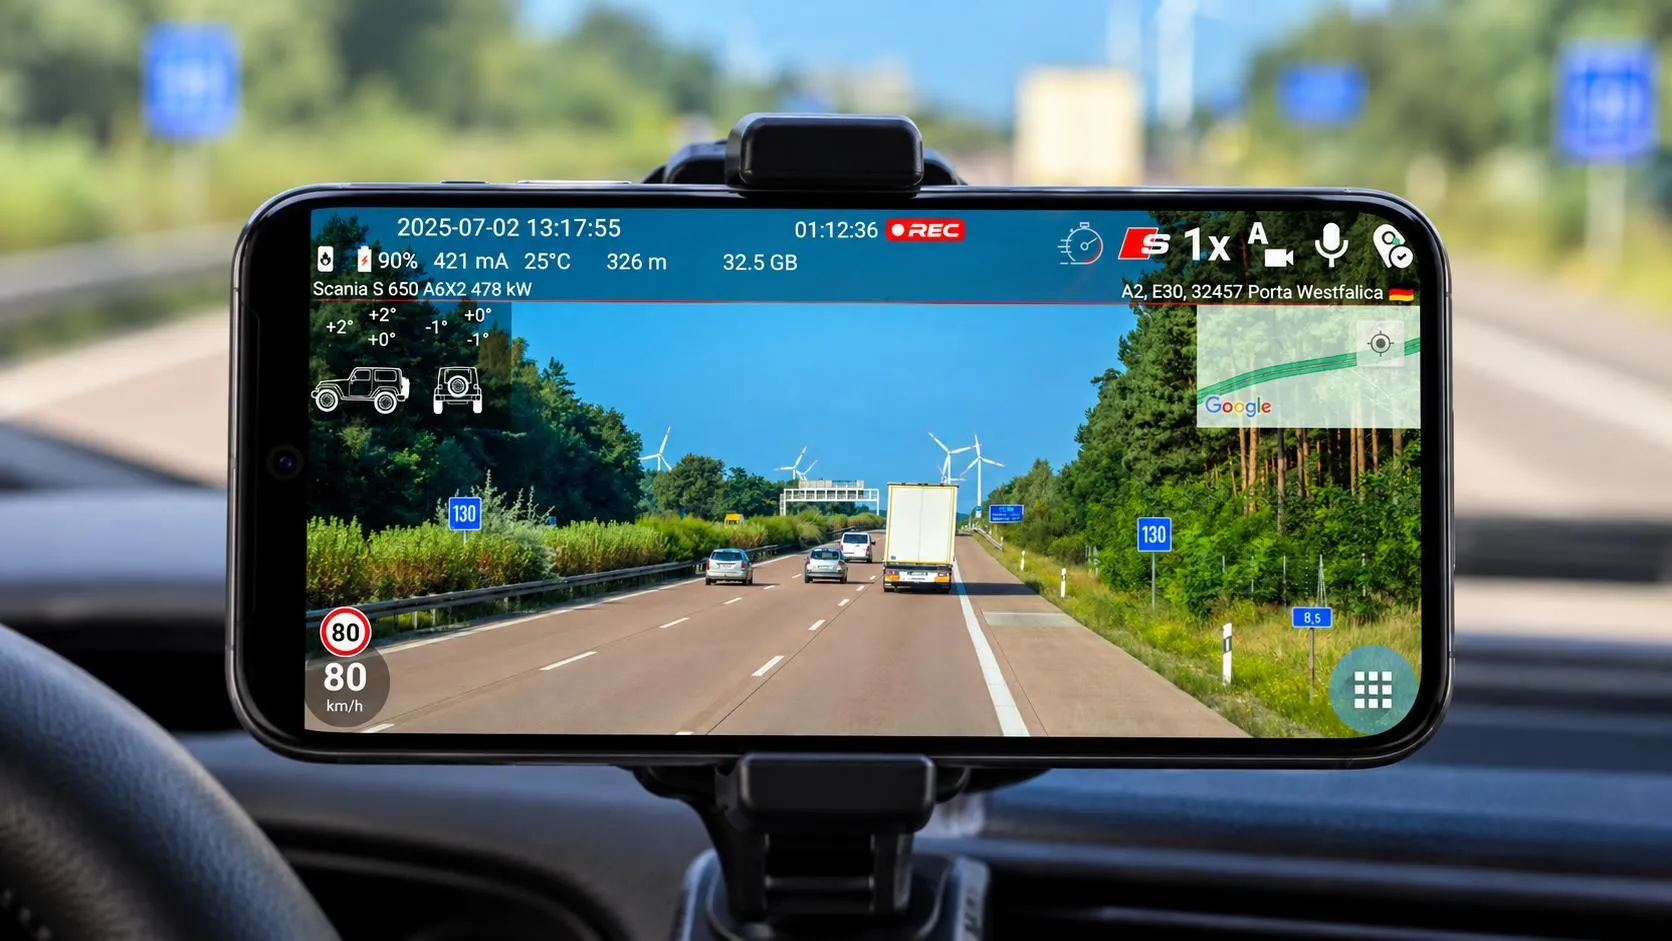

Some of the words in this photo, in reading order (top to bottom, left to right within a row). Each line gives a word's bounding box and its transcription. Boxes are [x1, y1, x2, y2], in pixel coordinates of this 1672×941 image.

[397, 217, 520, 237] 2025-07-02
[527, 218, 622, 238] 13:17:55
[794, 220, 879, 239] 01:12:36
[908, 222, 960, 238] REC
[1247, 221, 1269, 245] A
[1184, 227, 1231, 262] 1x
[378, 251, 418, 270] 90%
[433, 252, 468, 270] 421
[475, 253, 509, 270] mA
[524, 252, 572, 271] 25°C
[606, 253, 643, 271] 326
[648, 257, 667, 271] m
[722, 254, 765, 271] 32.5
[770, 254, 798, 271] GB
[312, 281, 368, 297] Scania
[373, 281, 384, 297] S
[388, 281, 419, 297] 650
[423, 281, 467, 297] A6X2
[471, 281, 502, 297] 478
[506, 281, 533, 297] kW
[1121, 284, 1148, 303] A2,
[1152, 285, 1187, 303] E30,
[1191, 284, 1243, 300] 32457
[1248, 284, 1293, 300] Porta
[1297, 283, 1384, 301] Westfalica
[368, 307, 397, 323] +2°
[464, 307, 492, 322] +0°
[326, 319, 354, 335] +2°
[425, 319, 448, 335] -1°
[367, 332, 396, 347] +0°
[466, 332, 489, 347] -1°
[1205, 396, 1272, 418] Google
[453, 504, 476, 522] 130
[1142, 525, 1166, 544] 130
[331, 622, 360, 643] 80
[323, 662, 367, 692] 80
[326, 699, 363, 713] km/h
